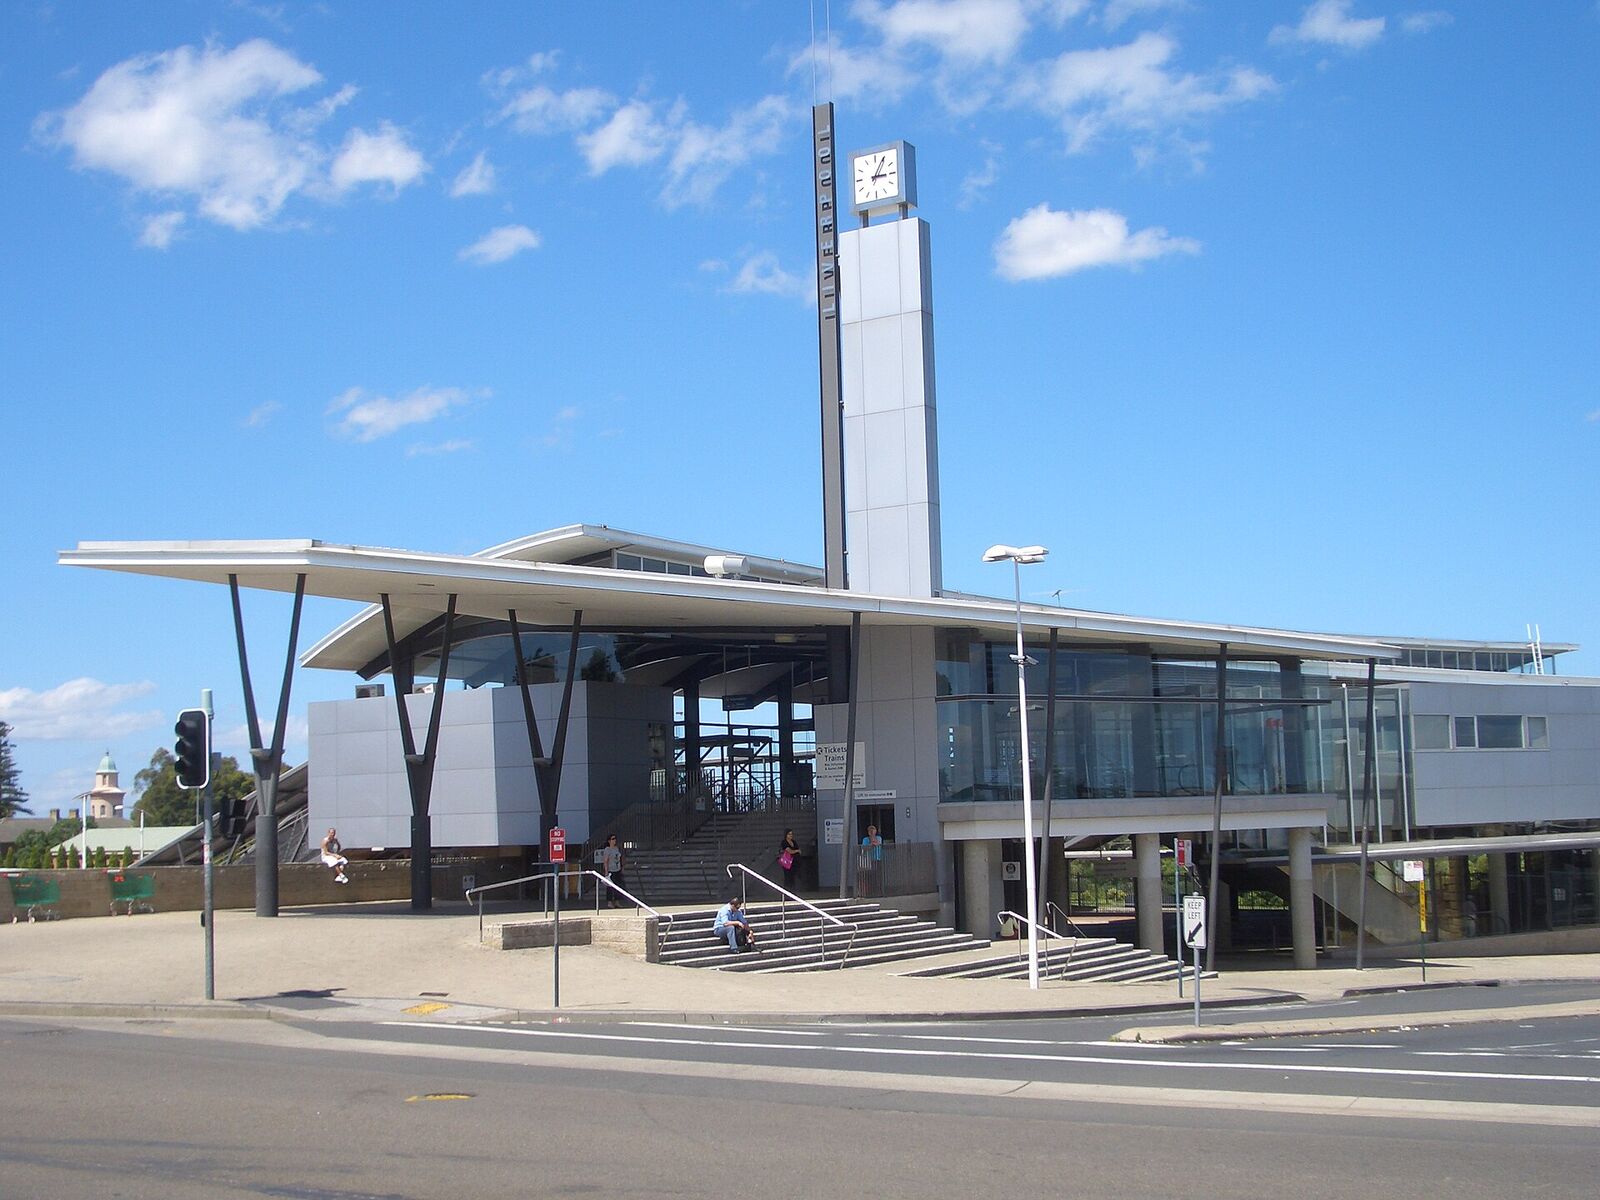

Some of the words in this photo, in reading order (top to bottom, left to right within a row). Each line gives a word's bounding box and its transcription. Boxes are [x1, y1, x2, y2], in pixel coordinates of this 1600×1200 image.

[818, 124, 836, 321] LIVERPOOL
[824, 746, 848, 754] Tickets
[824, 754, 845, 762] Trains
[1188, 901, 1202, 910] KEEP
[1188, 911, 1201, 920] LEFT
